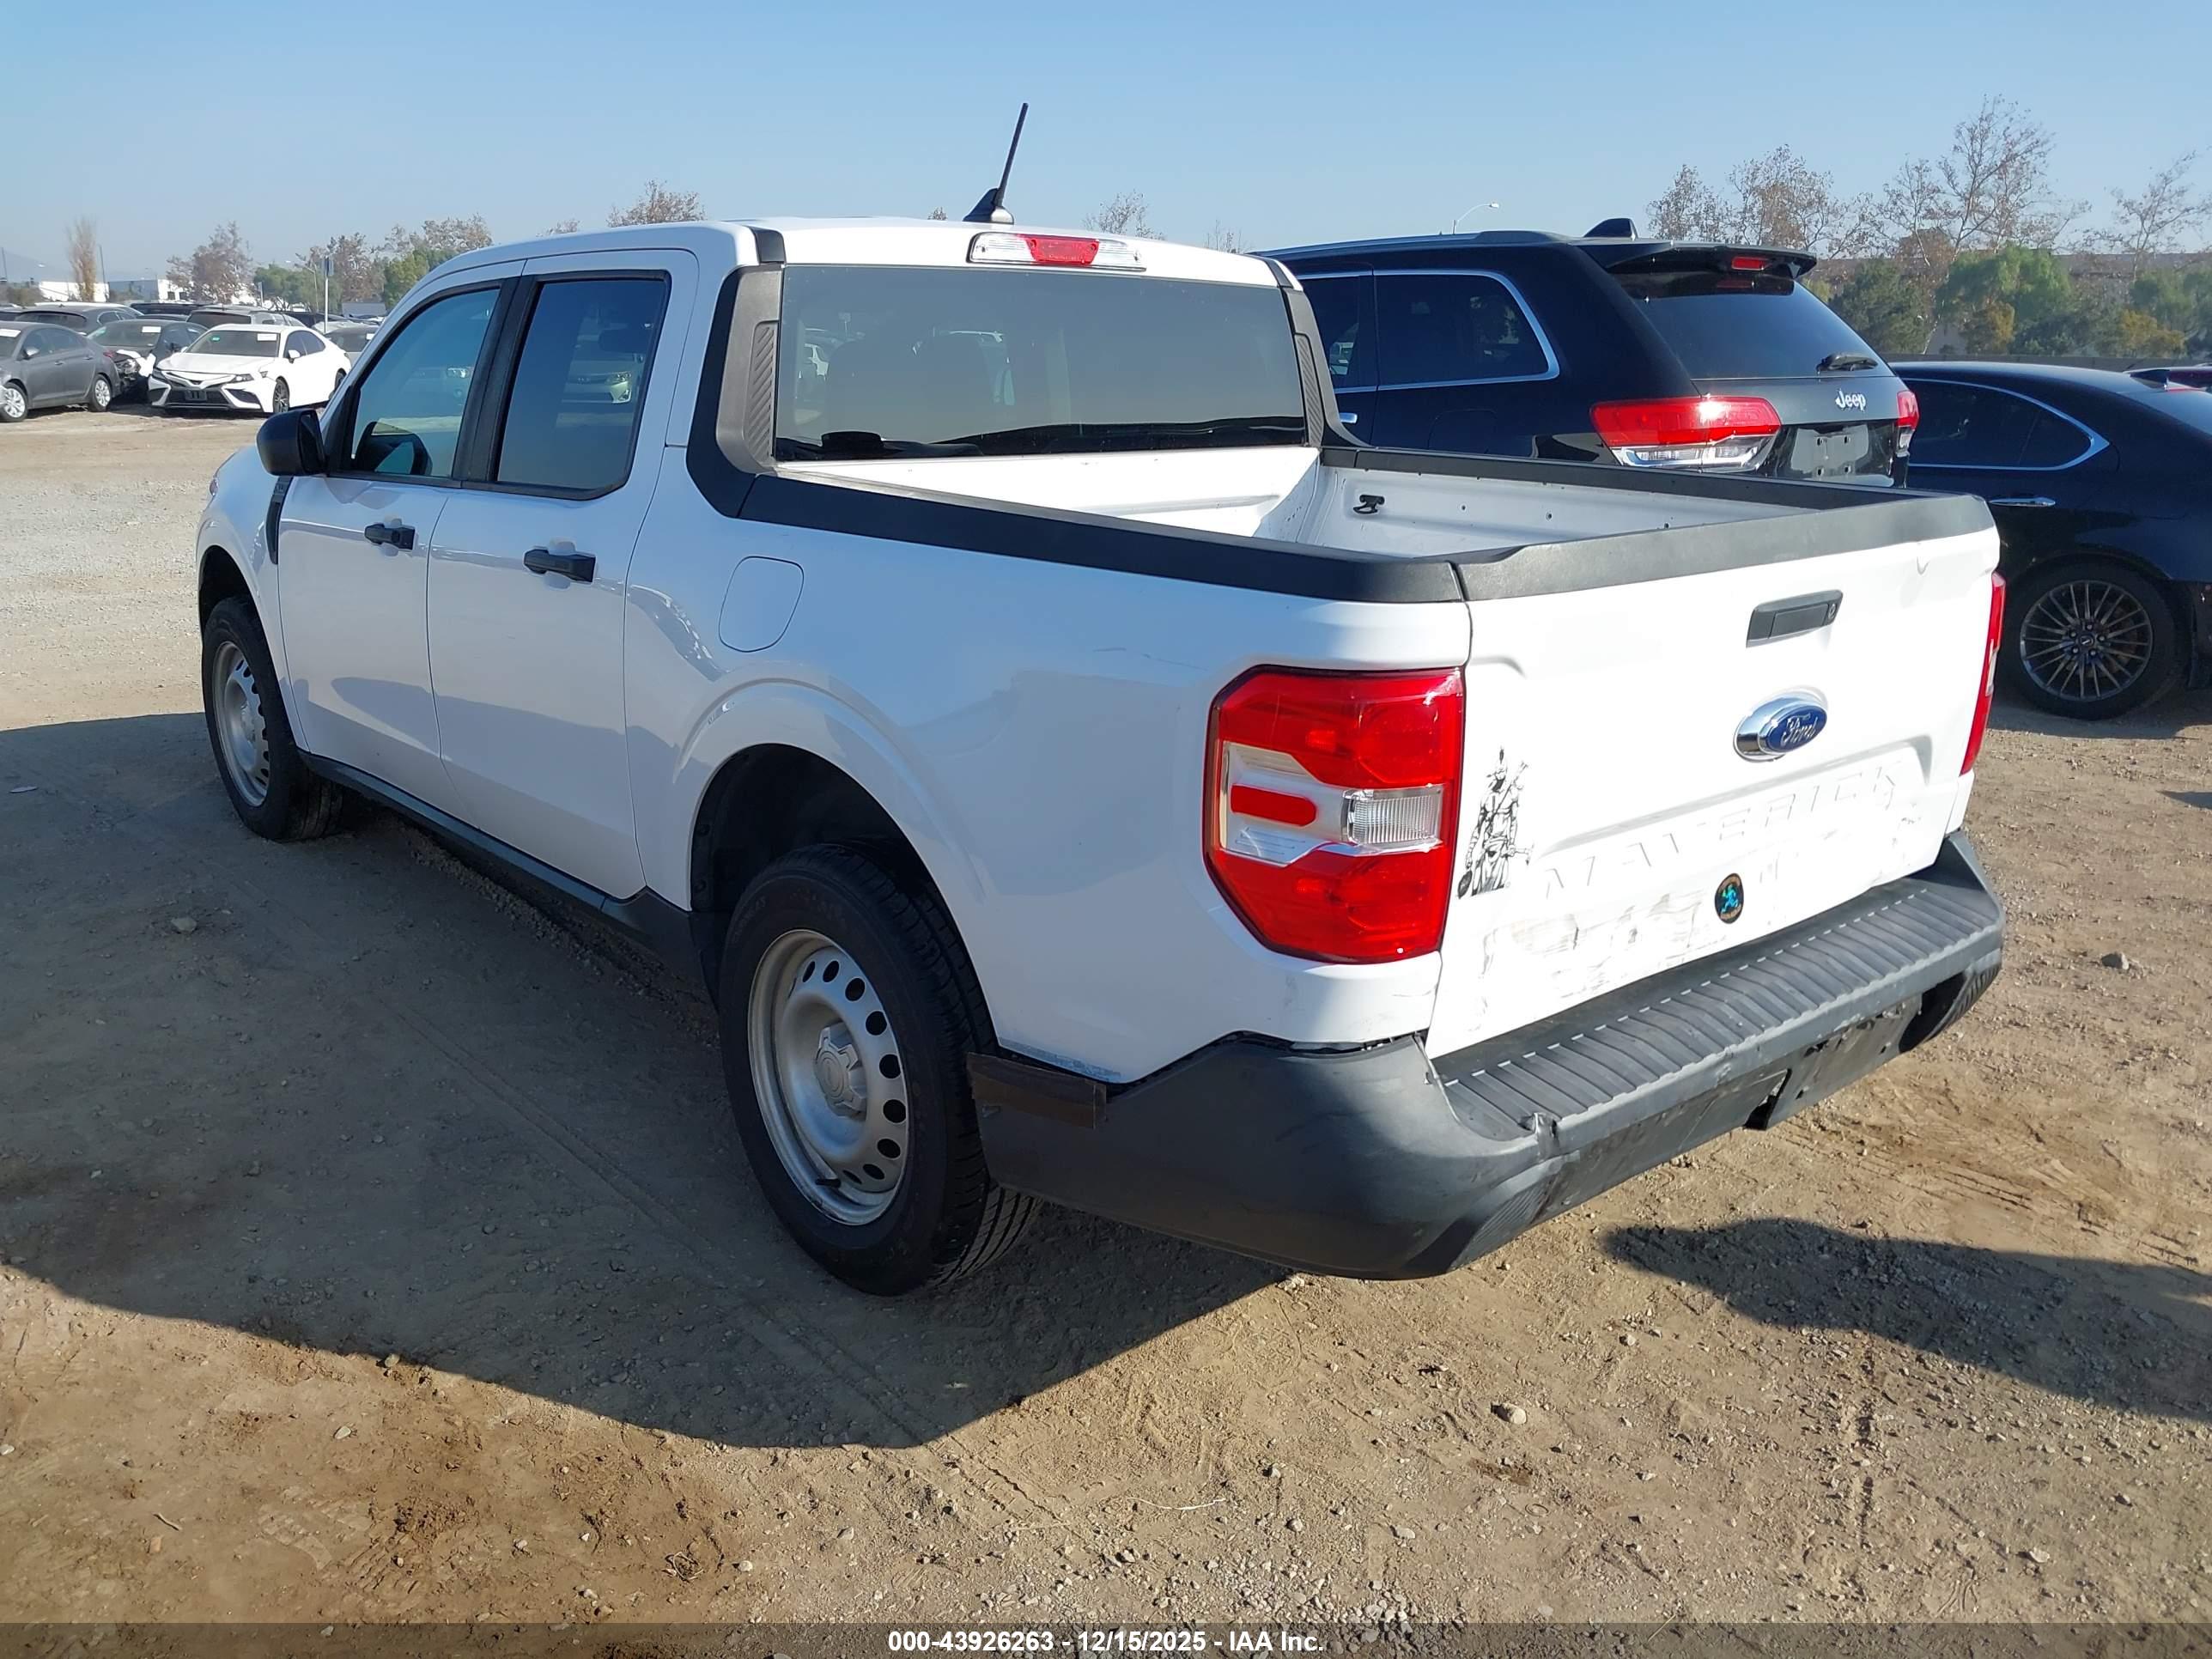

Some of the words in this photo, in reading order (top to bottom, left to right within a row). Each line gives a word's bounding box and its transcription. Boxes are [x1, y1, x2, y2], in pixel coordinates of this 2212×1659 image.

[1835, 389, 1866, 412] Jeep
[1780, 713, 1819, 747] Ford
[1545, 763, 1901, 900] MAVERICK
